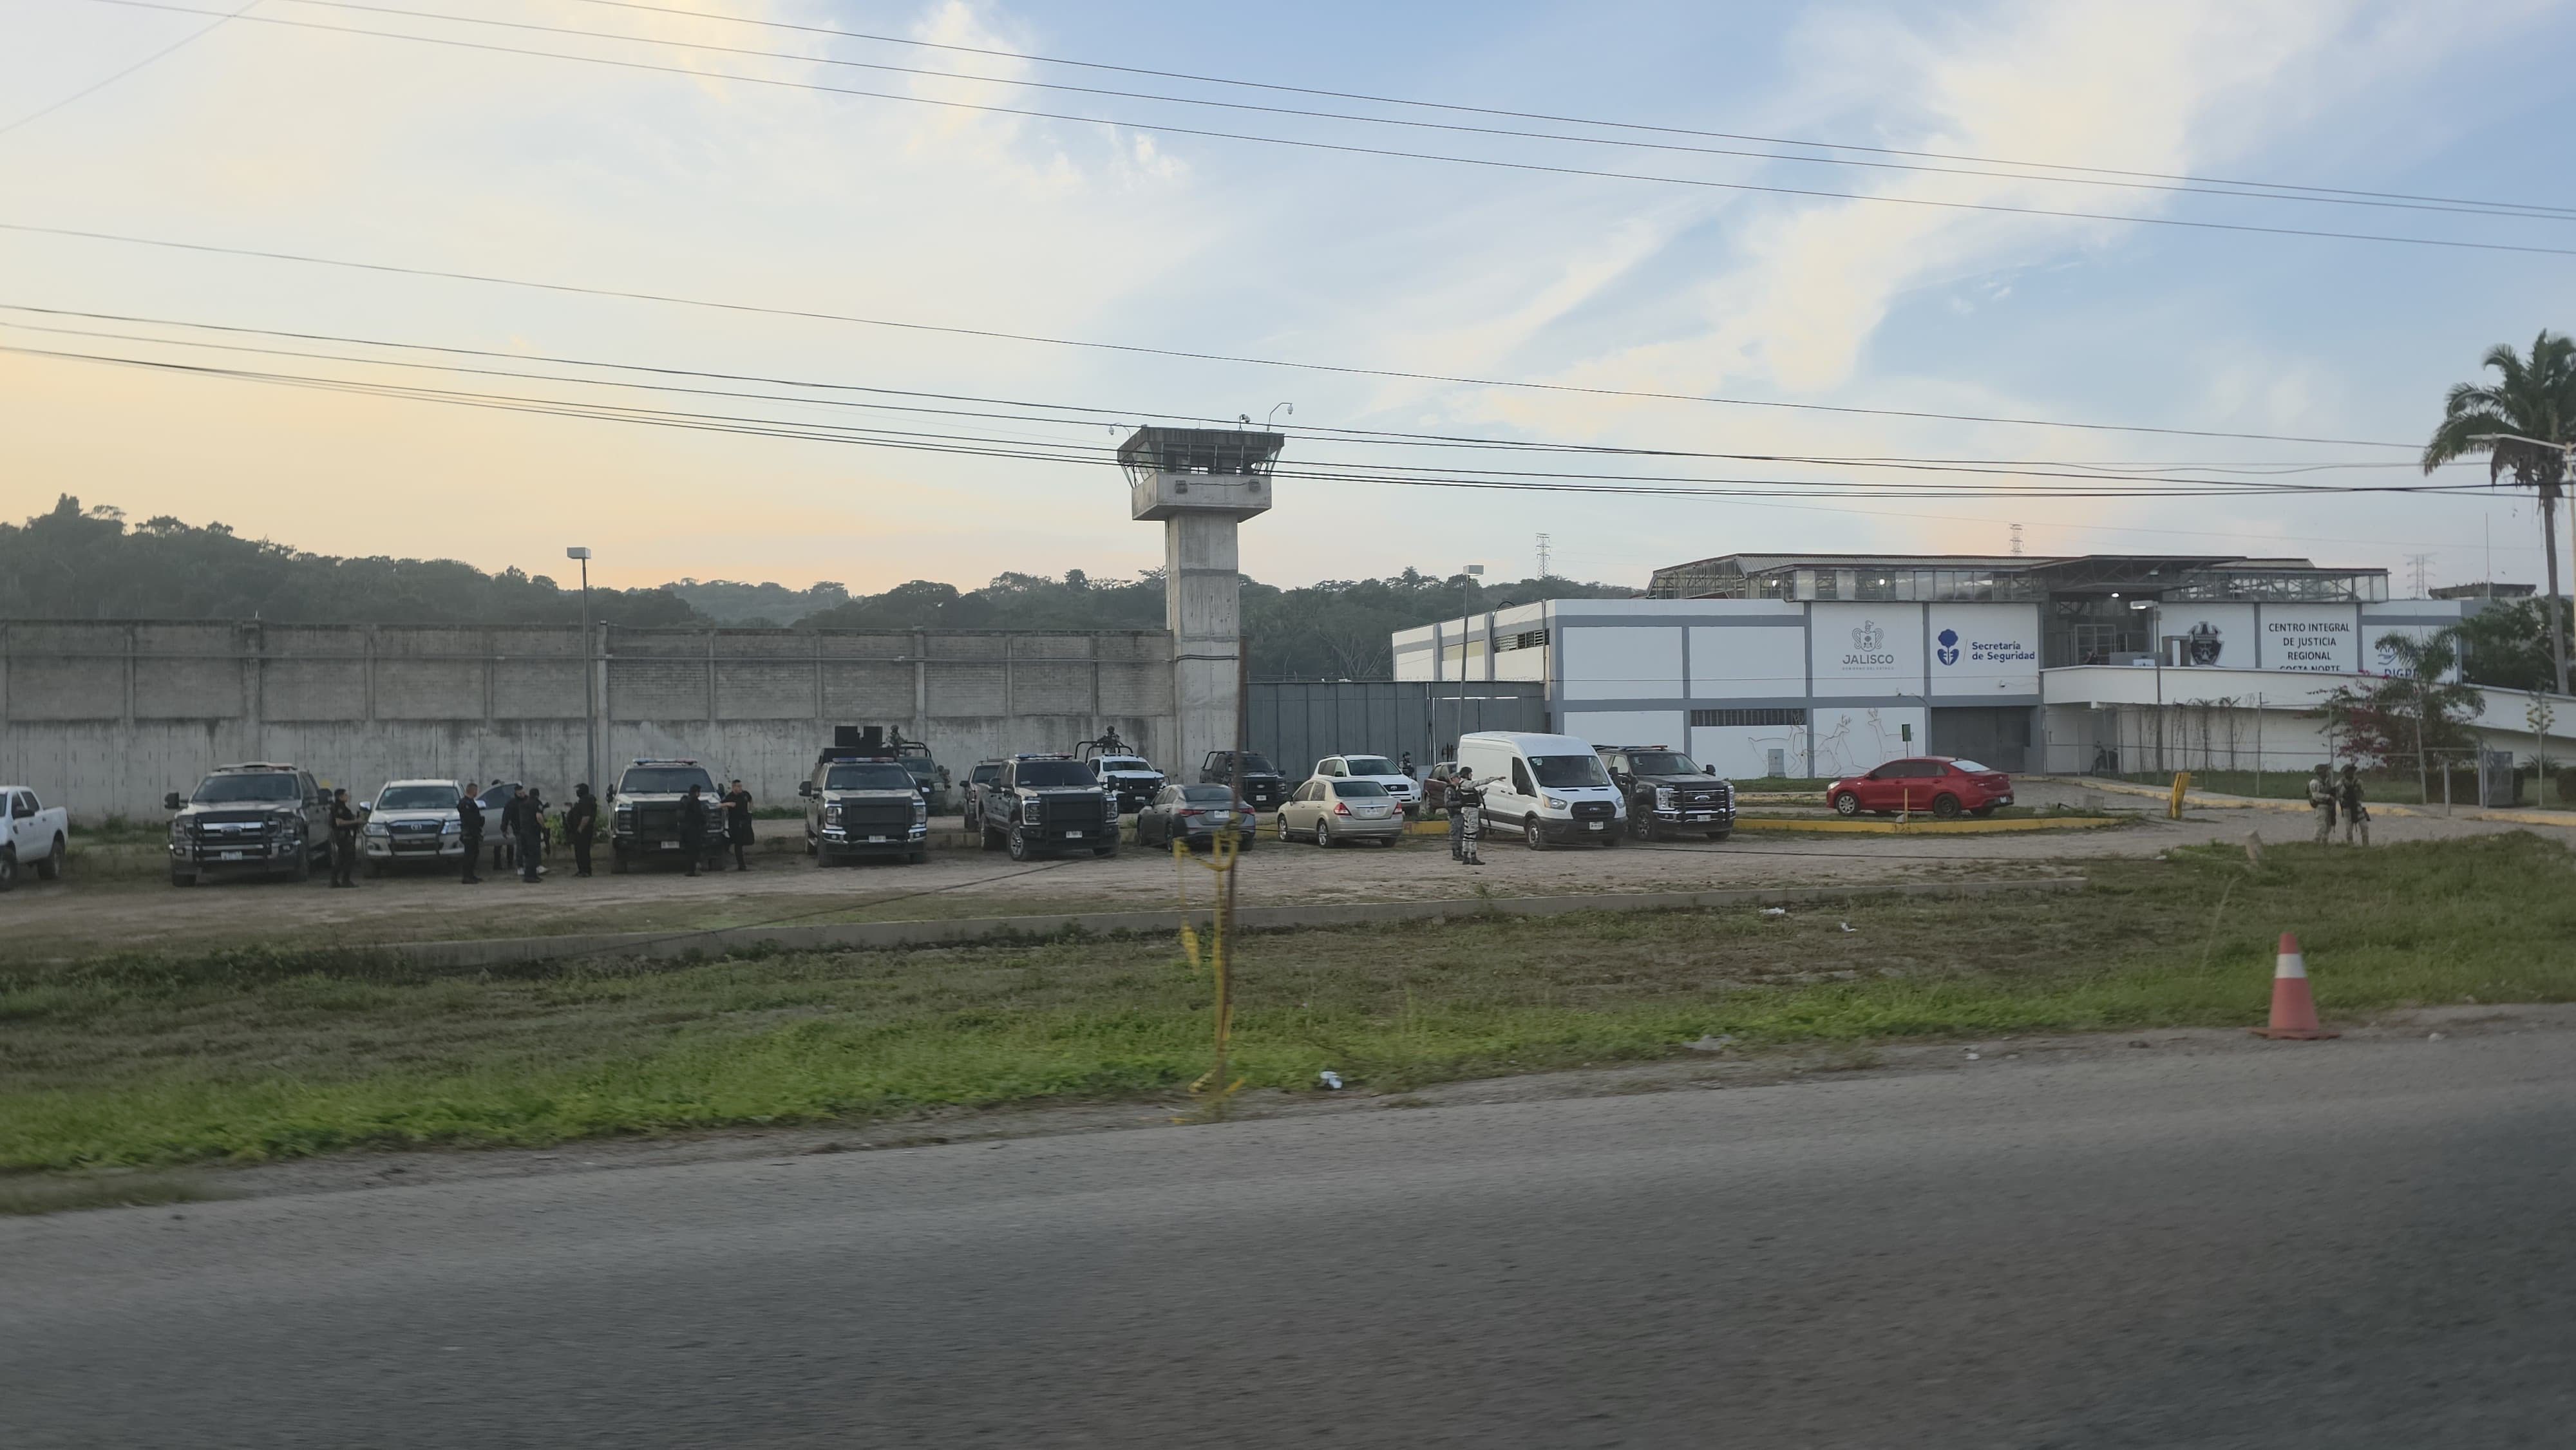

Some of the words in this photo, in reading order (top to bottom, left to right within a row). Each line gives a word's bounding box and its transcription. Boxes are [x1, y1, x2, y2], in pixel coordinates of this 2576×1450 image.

[2269, 623, 2306, 632] CENTRO
[2308, 623, 2350, 632] INTEGRAL
[1972, 641, 2021, 650] Secretaría
[2283, 637, 2295, 646] DE
[2297, 637, 2336, 648] JUSTICIA
[1842, 654, 1894, 664] JALISCO
[1972, 652, 1984, 660] de
[1987, 651, 2035, 663] Seguridad
[2287, 651, 2331, 660] REGIONAL
